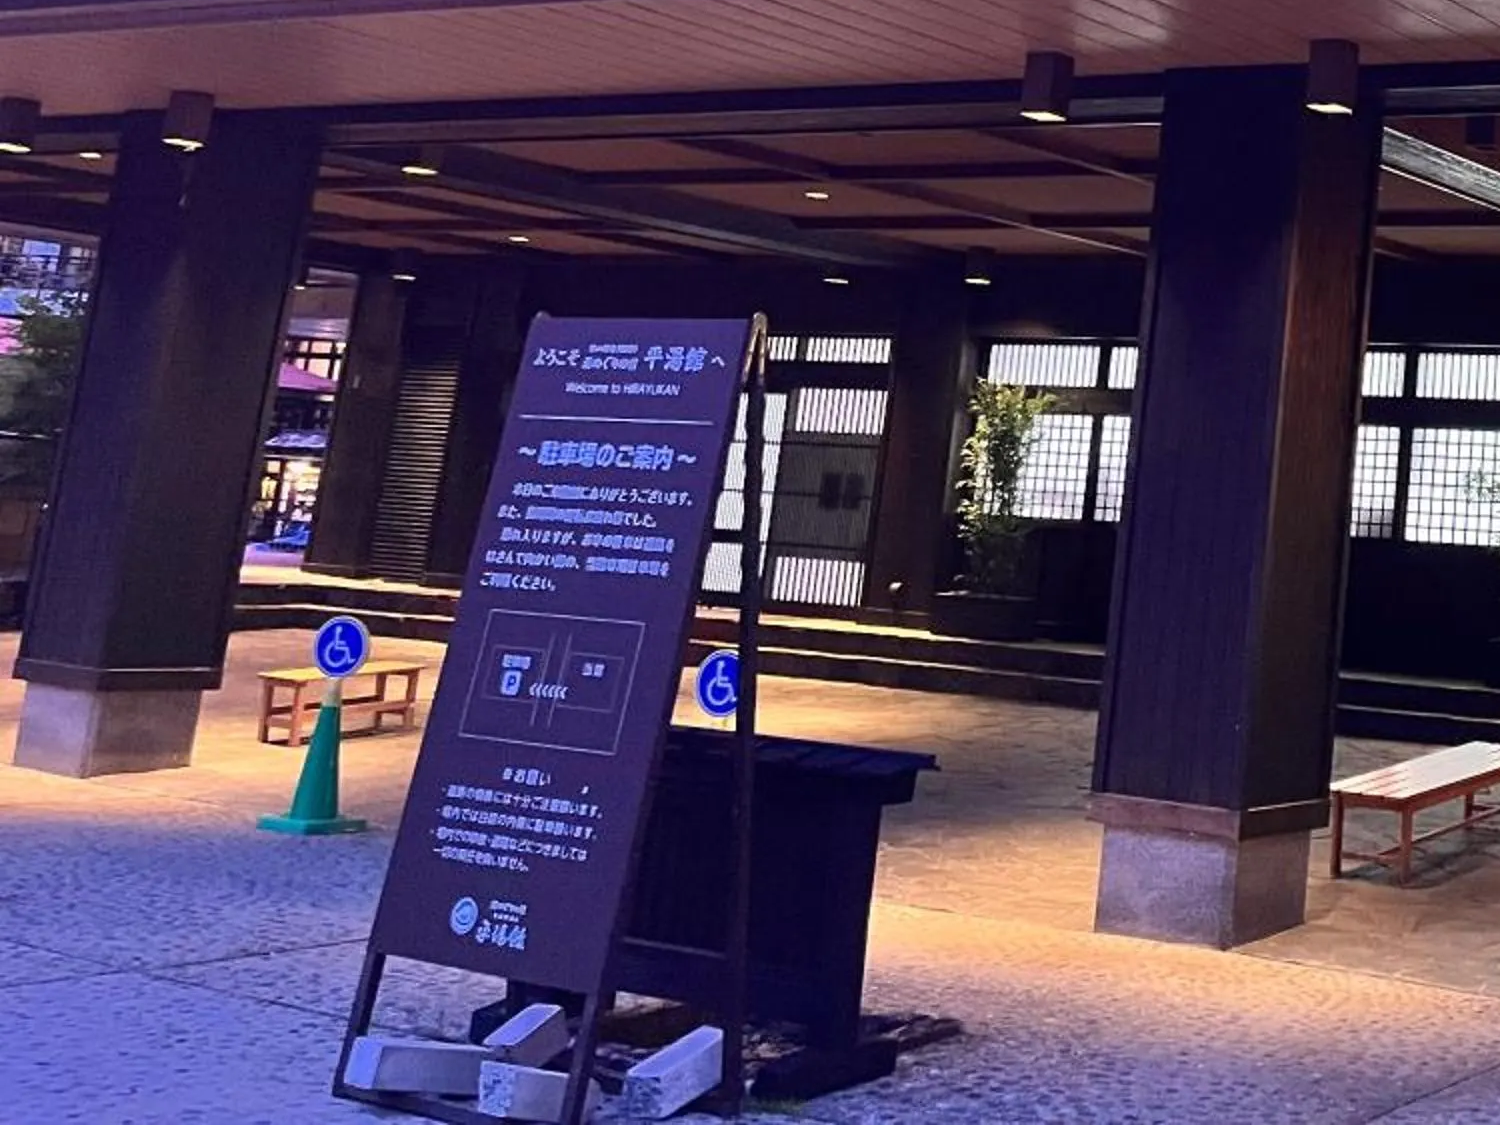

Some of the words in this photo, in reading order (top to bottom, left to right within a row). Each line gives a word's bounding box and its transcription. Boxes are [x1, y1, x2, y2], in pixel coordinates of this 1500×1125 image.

[643, 346, 708, 372] 平湯館
[565, 382, 609, 394] Welcome
[610, 383, 620, 394] to
